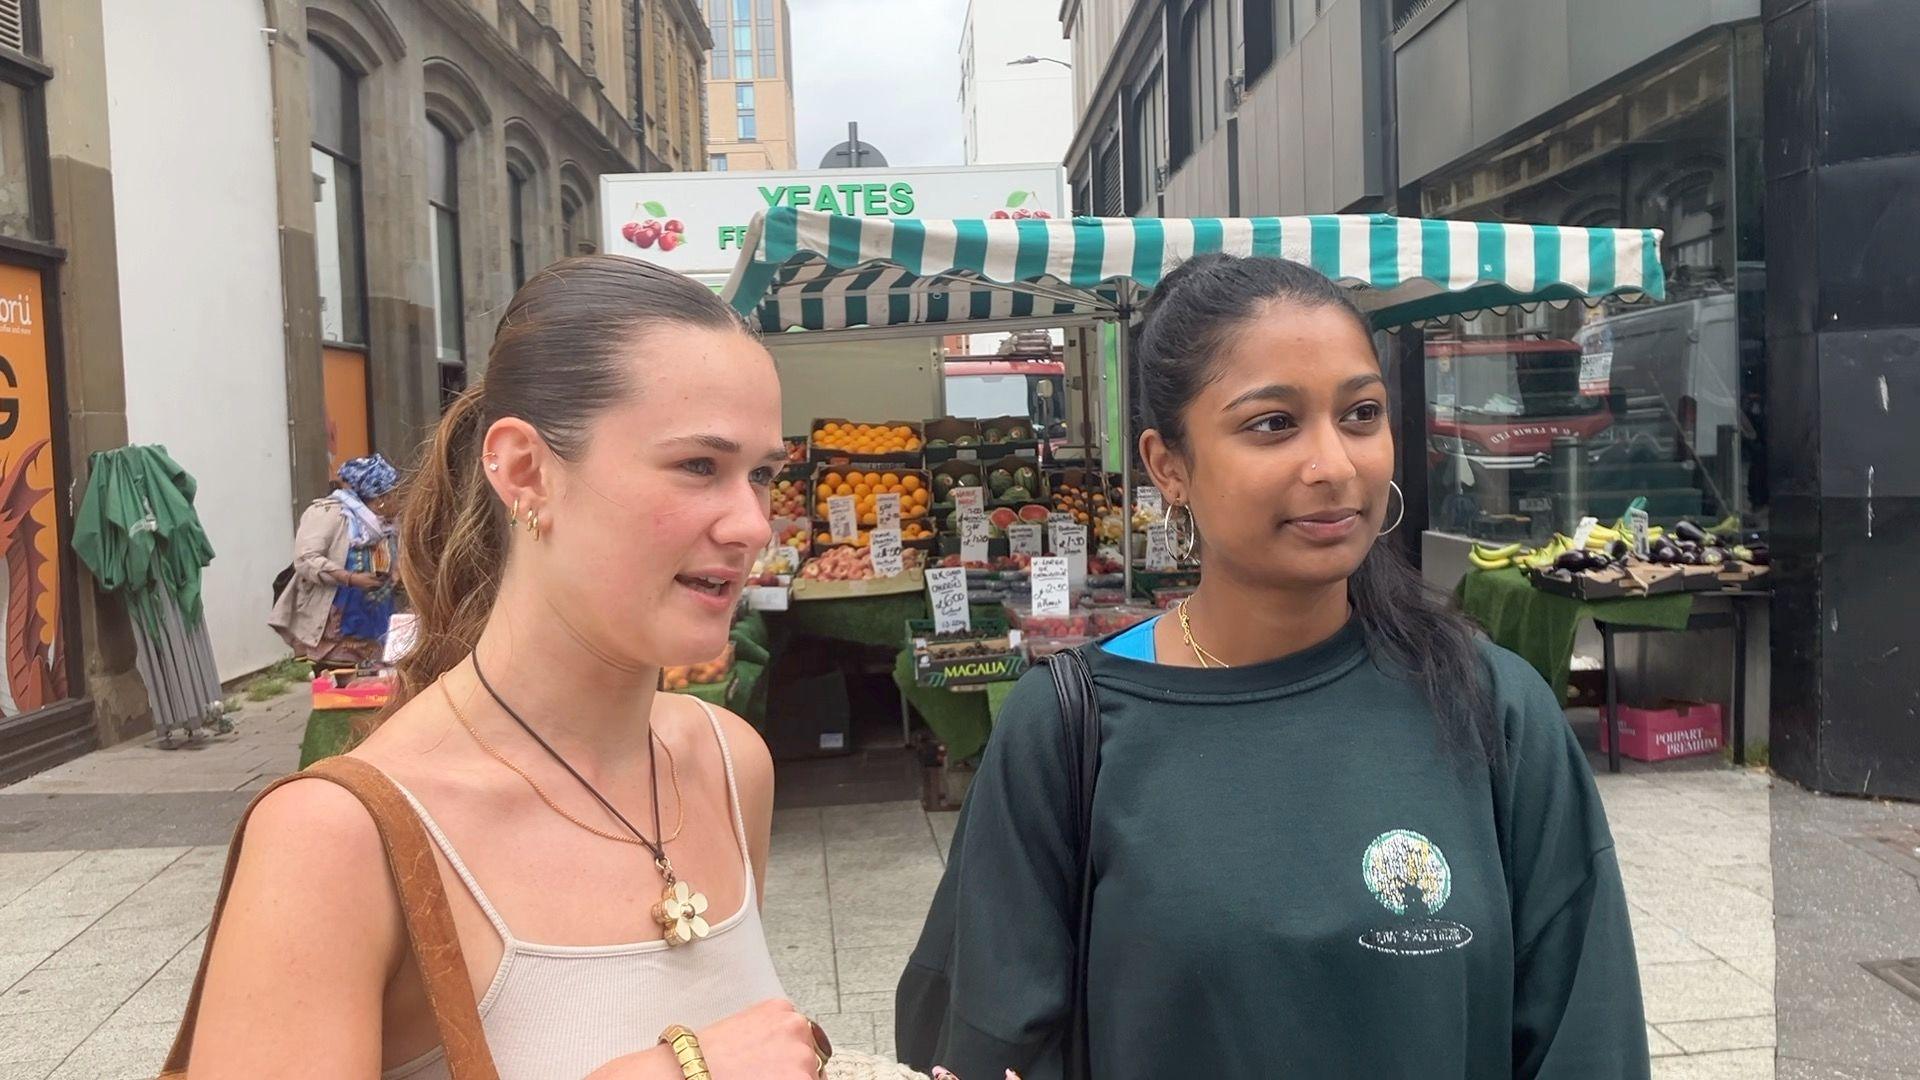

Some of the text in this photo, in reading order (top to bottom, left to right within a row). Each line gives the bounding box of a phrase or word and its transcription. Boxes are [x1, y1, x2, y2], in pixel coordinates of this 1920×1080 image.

[758, 182, 915, 217] YEATES
[944, 661, 1006, 678] MAGALIA
[1655, 728, 1703, 746] POUPART
[1667, 738, 1718, 756] PREMIUM
